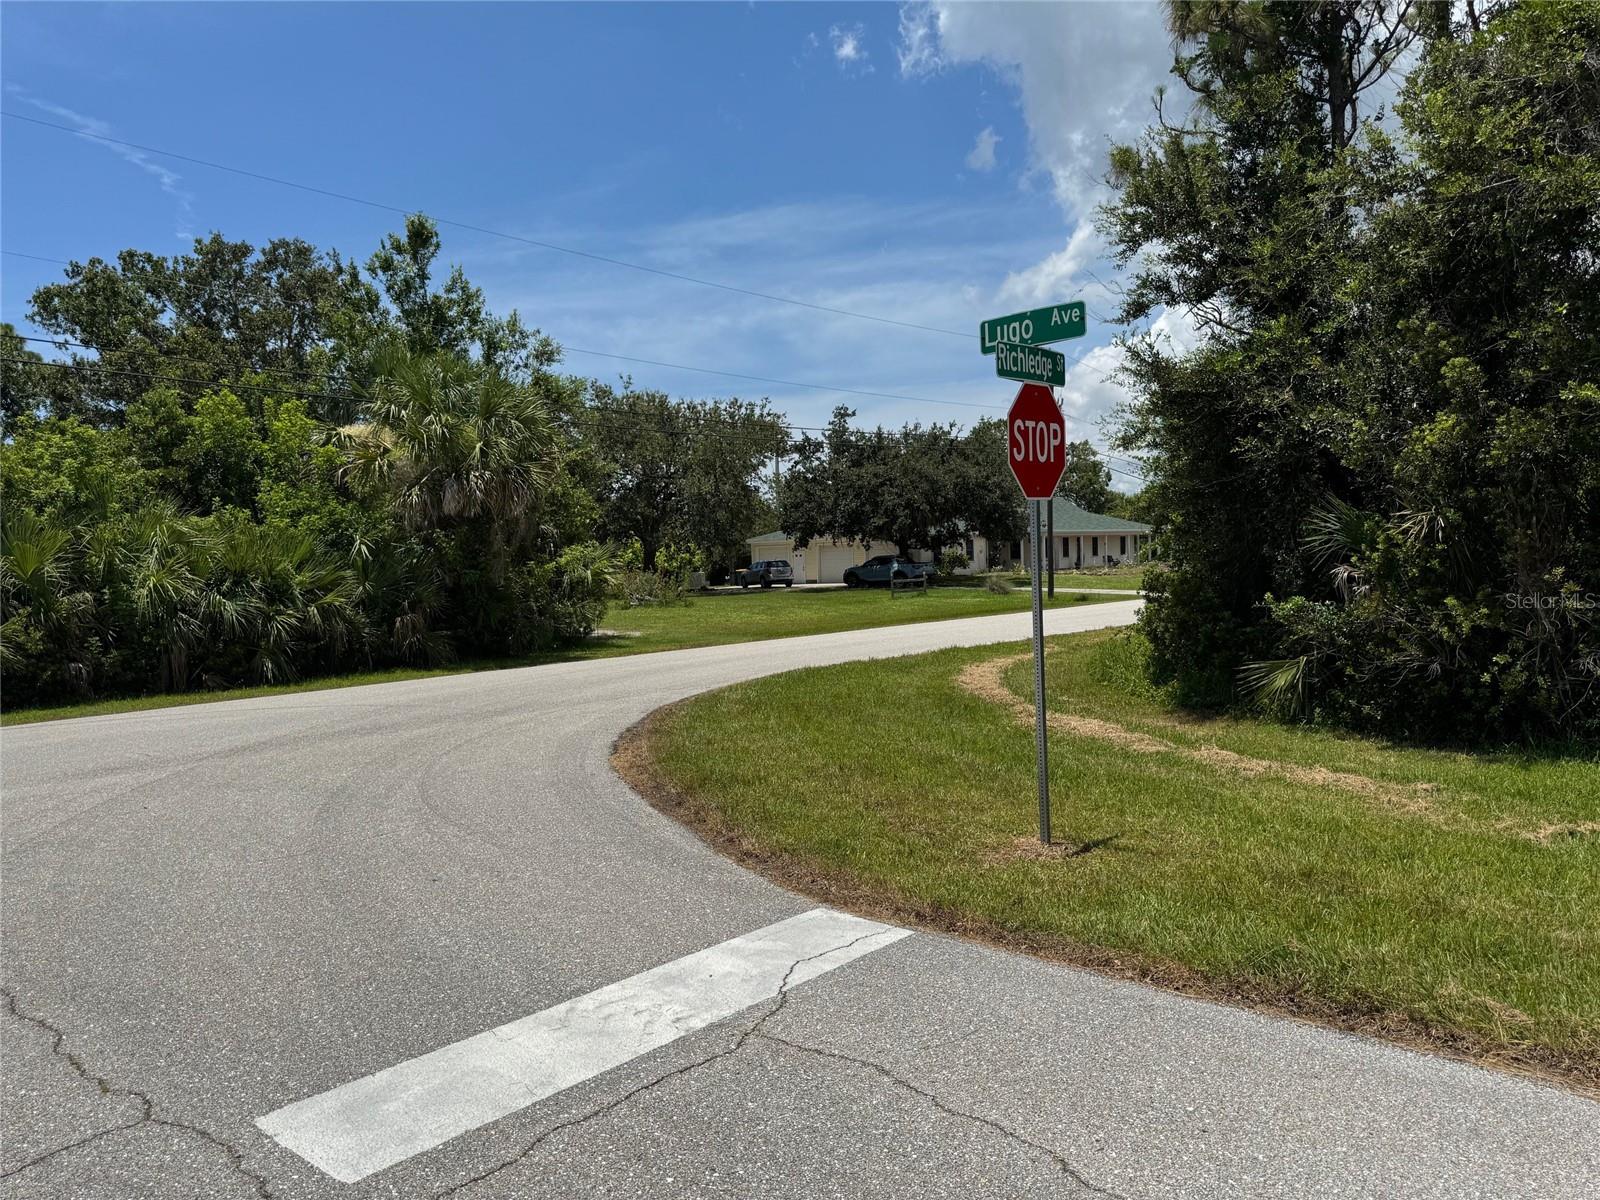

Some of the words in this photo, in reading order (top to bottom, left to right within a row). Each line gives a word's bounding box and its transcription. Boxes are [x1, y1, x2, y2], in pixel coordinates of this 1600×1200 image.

[985, 319, 1033, 347] Lugo
[1051, 308, 1080, 326] Ave
[998, 343, 1052, 380] Richledge
[1056, 355, 1064, 373] St
[1013, 419, 1061, 462] STOP
